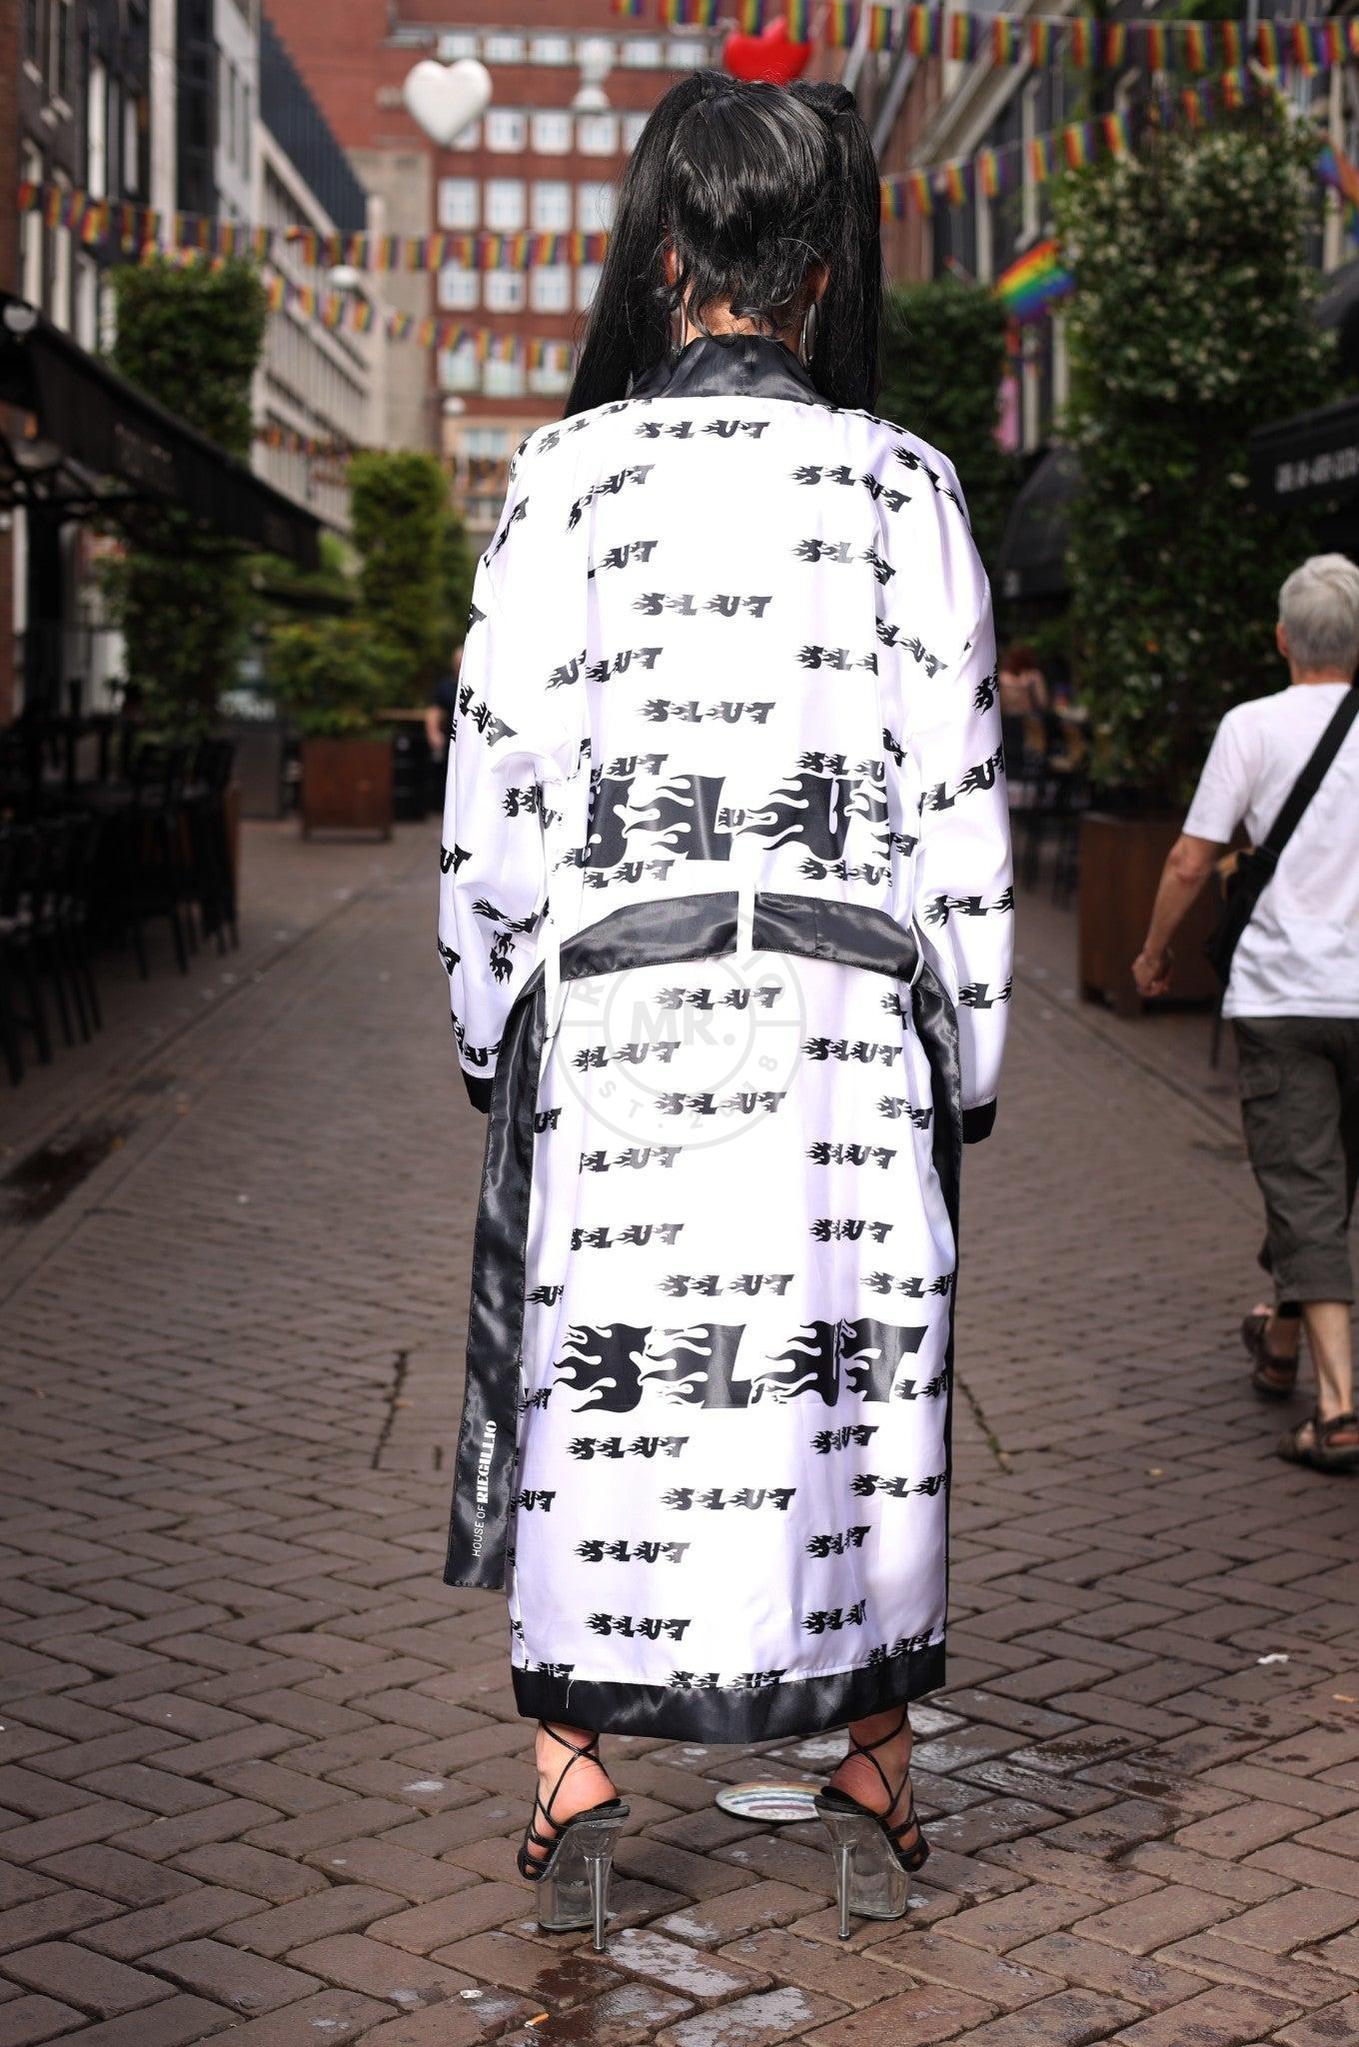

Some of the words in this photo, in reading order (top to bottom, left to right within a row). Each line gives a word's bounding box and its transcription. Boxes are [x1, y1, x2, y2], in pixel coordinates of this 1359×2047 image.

[632, 419, 771, 439] SLUT
[631, 592, 773, 618] SLUT
[875, 616, 948, 679] LUT
[585, 647, 664, 683] LUT
[459, 683, 518, 748] LUT
[635, 698, 776, 724] SLUT
[793, 751, 885, 782] SLU
[440, 840, 473, 875] UT
[584, 859, 676, 889] LUT
[654, 986, 783, 1011] SLUT
[800, 1037, 904, 1068] SLUT
[655, 1091, 787, 1115] SLUT
[534, 1107, 562, 1134] UT
[579, 1146, 683, 1175] LUT
[804, 1141, 899, 1170] SLUT
[570, 1222, 685, 1251] SLUT
[654, 1273, 796, 1298] SLUT
[859, 1270, 953, 1299] SLU
[552, 1316, 929, 1414] SLUT
[476, 1419, 498, 1504] RIEGILLIO
[565, 1435, 690, 1461] SLUT
[476, 1504, 487, 1519] OF
[513, 1488, 557, 1513] UT
[657, 1486, 797, 1511] SLUT
[471, 1521, 485, 1557] HOUSE
[572, 1539, 693, 1564] SLUT
[583, 1612, 692, 1642] SLUT
